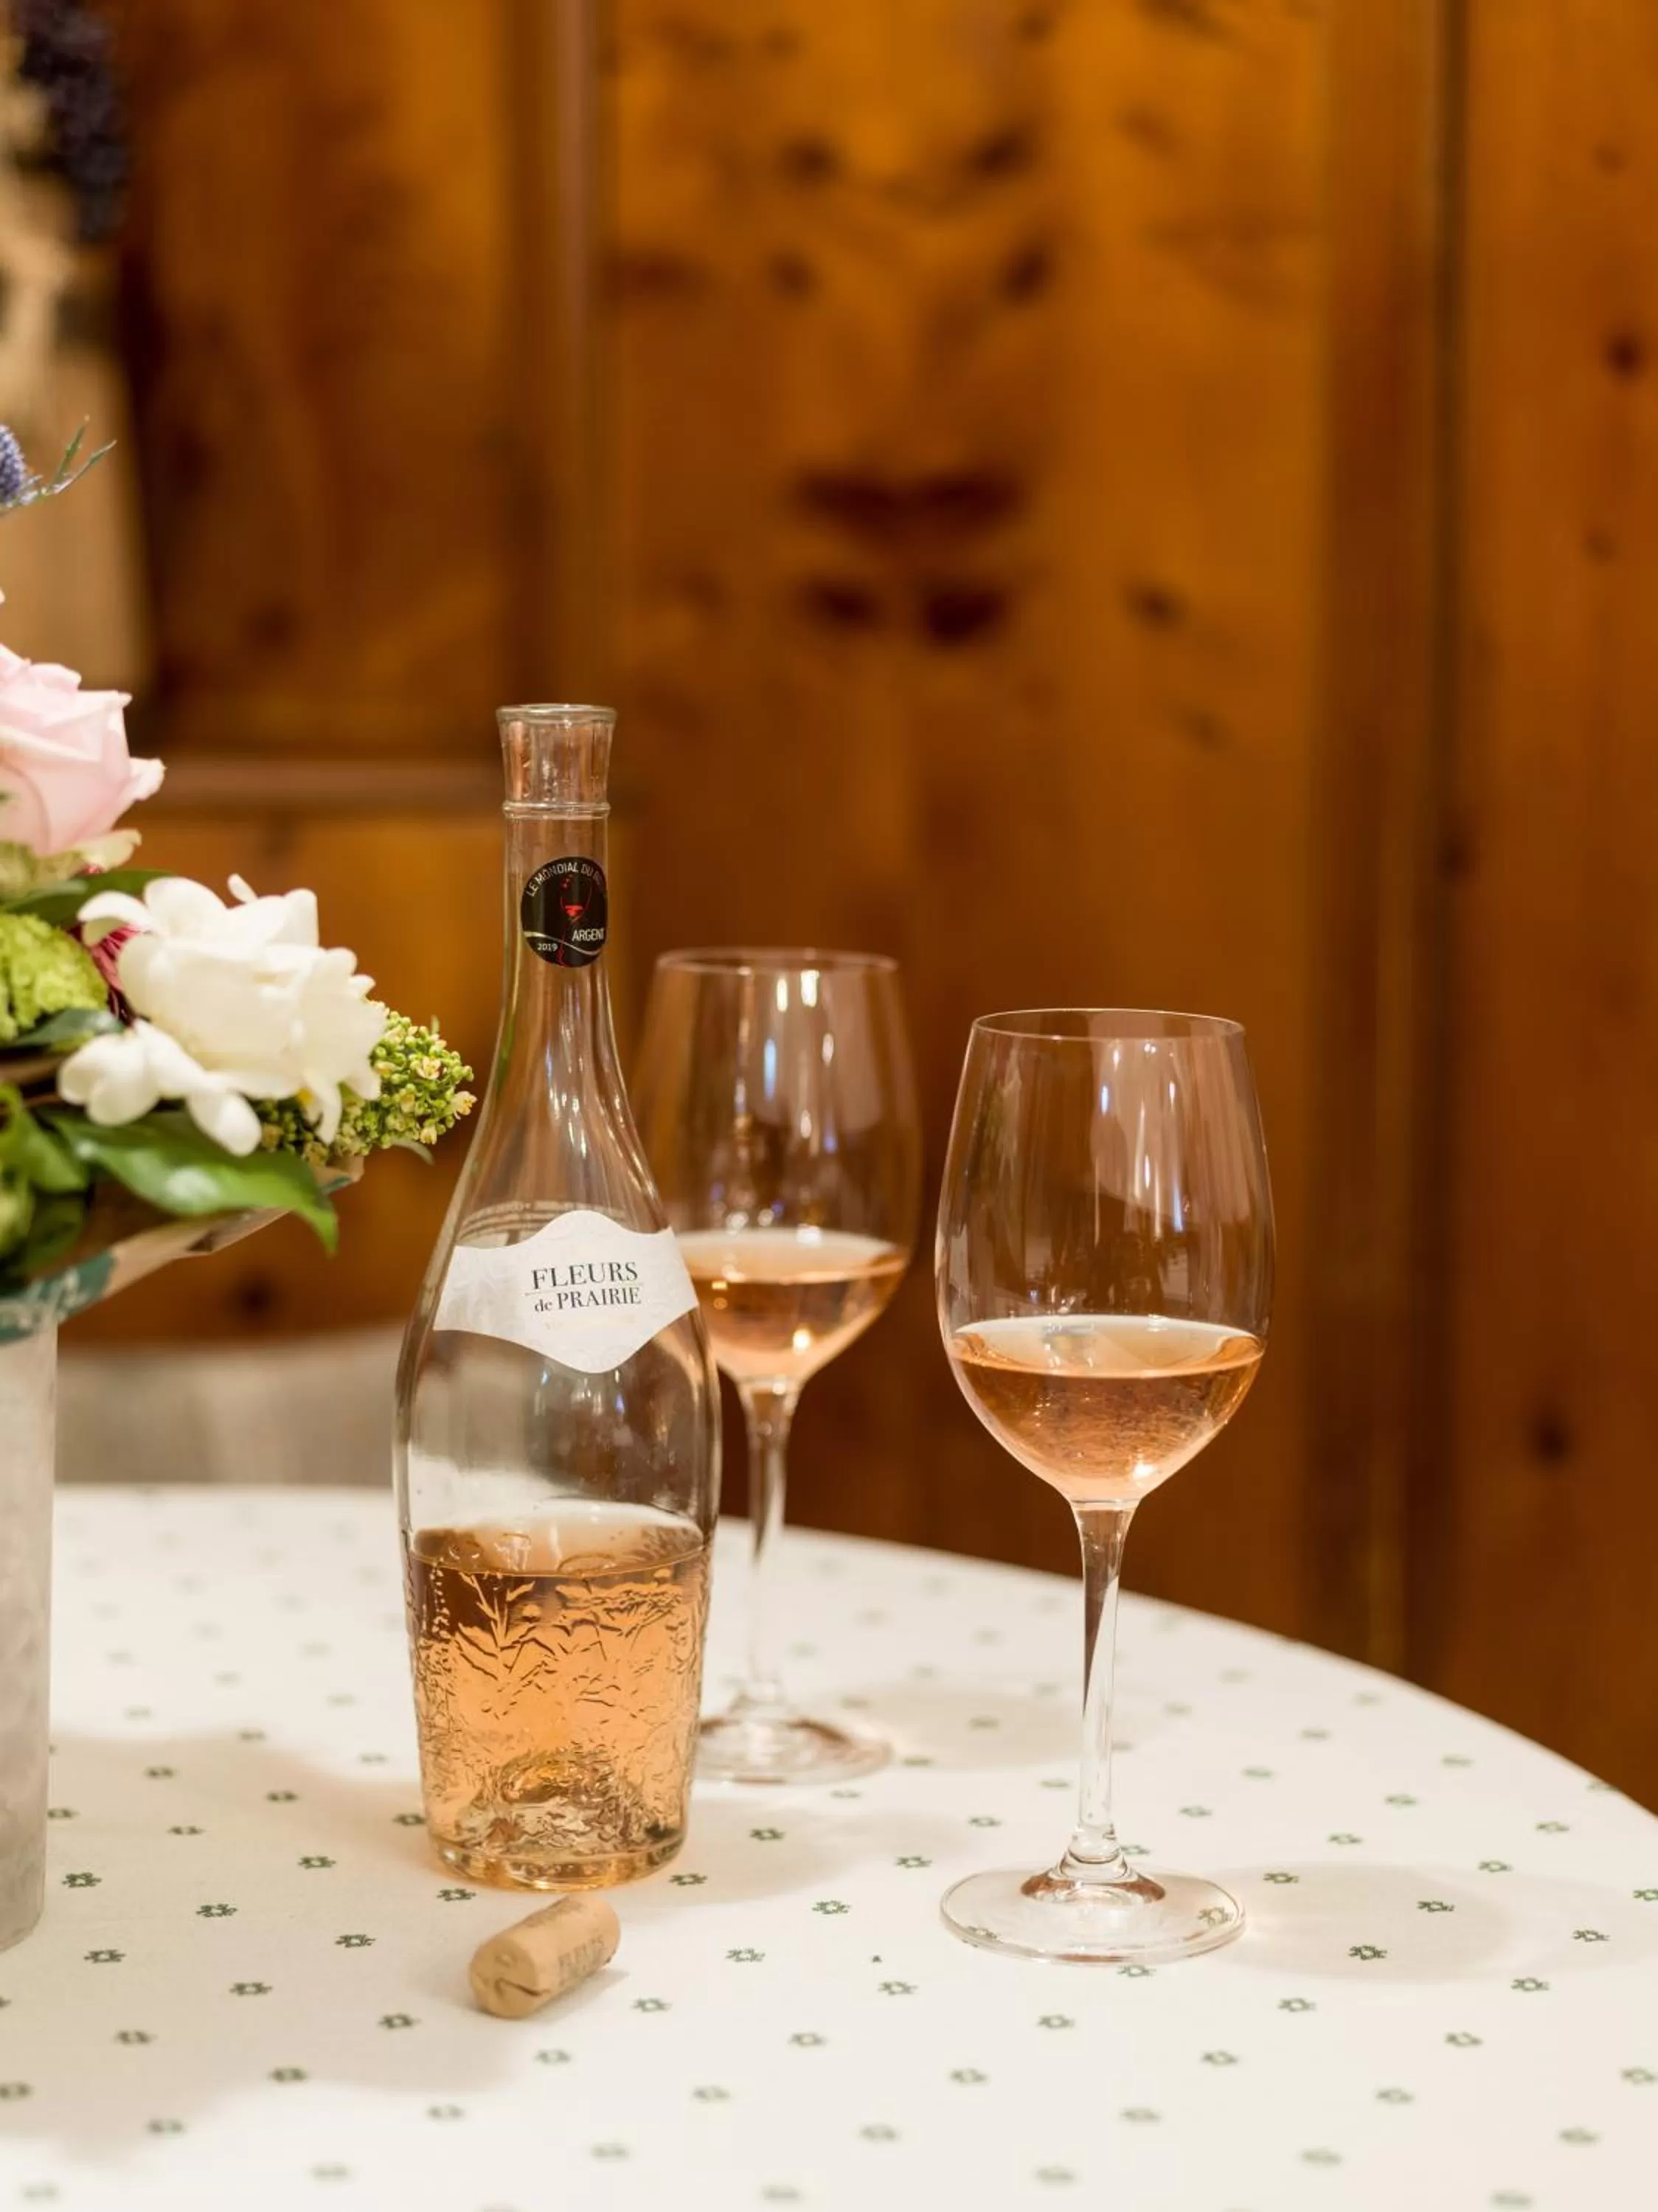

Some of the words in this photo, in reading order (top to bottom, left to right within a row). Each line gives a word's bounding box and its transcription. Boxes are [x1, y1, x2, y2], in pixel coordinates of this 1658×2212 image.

[525, 881, 540, 897] LE
[535, 861, 579, 886] MONDIAL
[580, 863, 594, 877] DU
[537, 943, 558, 952] 2019
[530, 1262, 639, 1290] FLEURS
[534, 1299, 553, 1313] de
[556, 1287, 642, 1310] PRAIRIE
